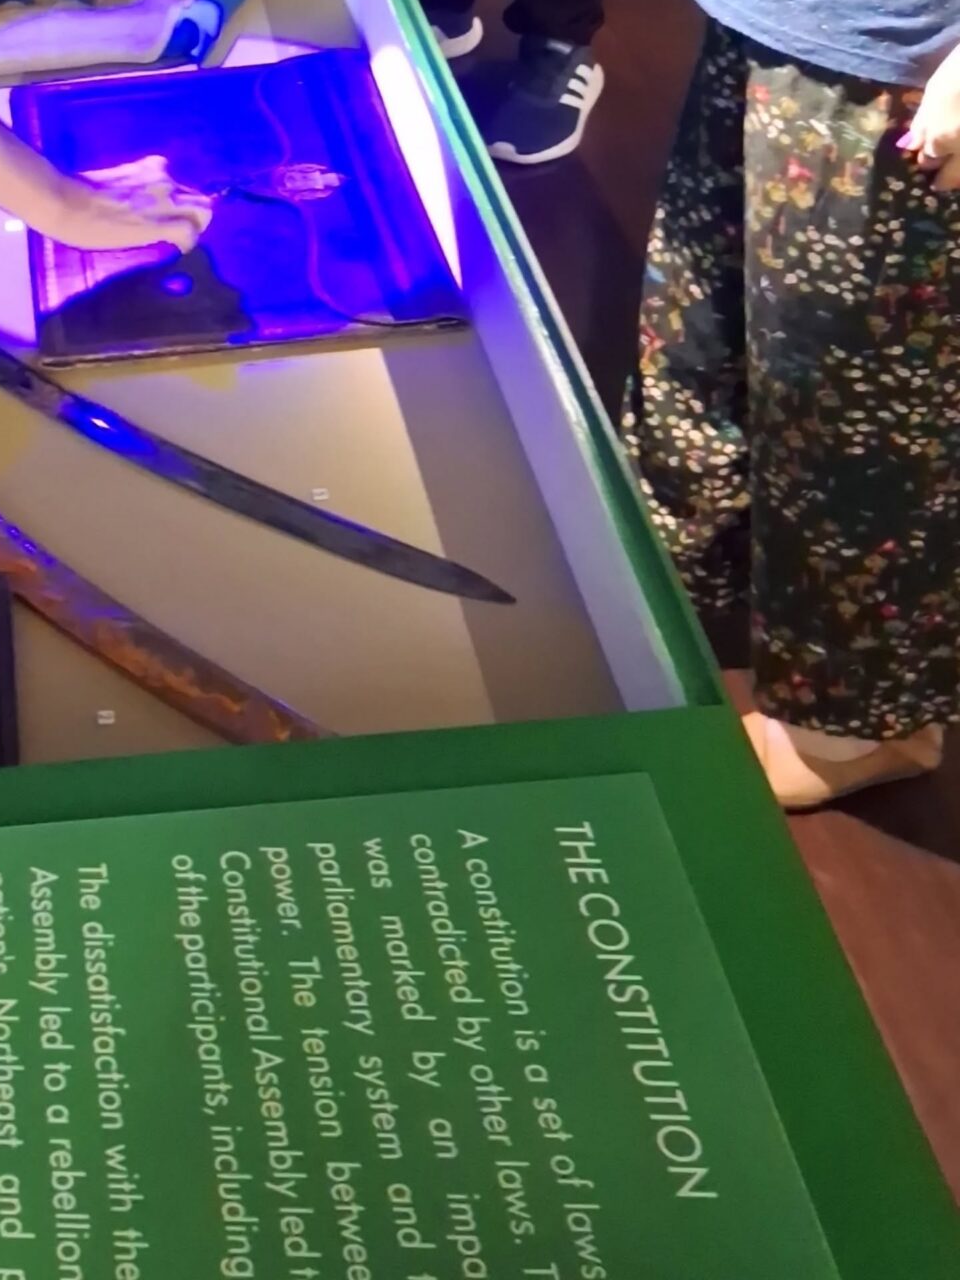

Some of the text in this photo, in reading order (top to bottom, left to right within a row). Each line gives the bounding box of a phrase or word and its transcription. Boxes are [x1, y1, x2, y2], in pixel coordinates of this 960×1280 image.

[220, 851, 283, 1040] Constitutional
[259, 847, 302, 935] power.
[410, 834, 485, 1003] contradicted
[171, 855, 259, 1277] of the participants, including
[288, 956, 323, 1007] The
[306, 843, 375, 1035] parliamentary
[353, 1056, 403, 1159] system
[387, 1183, 437, 1248] and
[363, 838, 487, 1278] was marked by an impa
[453, 1017, 491, 1051] by
[457, 829, 606, 1279] A constitution is a set of laws
[554, 821, 718, 1198] THE CONSTITUTION
[28, 867, 91, 1280] Assembly led to a rebellion
[78, 863, 149, 1280] The dissatisfaction with the
[251, 1048, 307, 1198] Assembly
[301, 1028, 345, 1137] tension
[470, 1064, 512, 1146] other
[279, 1207, 322, 1257] led
[495, 1161, 535, 1244] laws.
